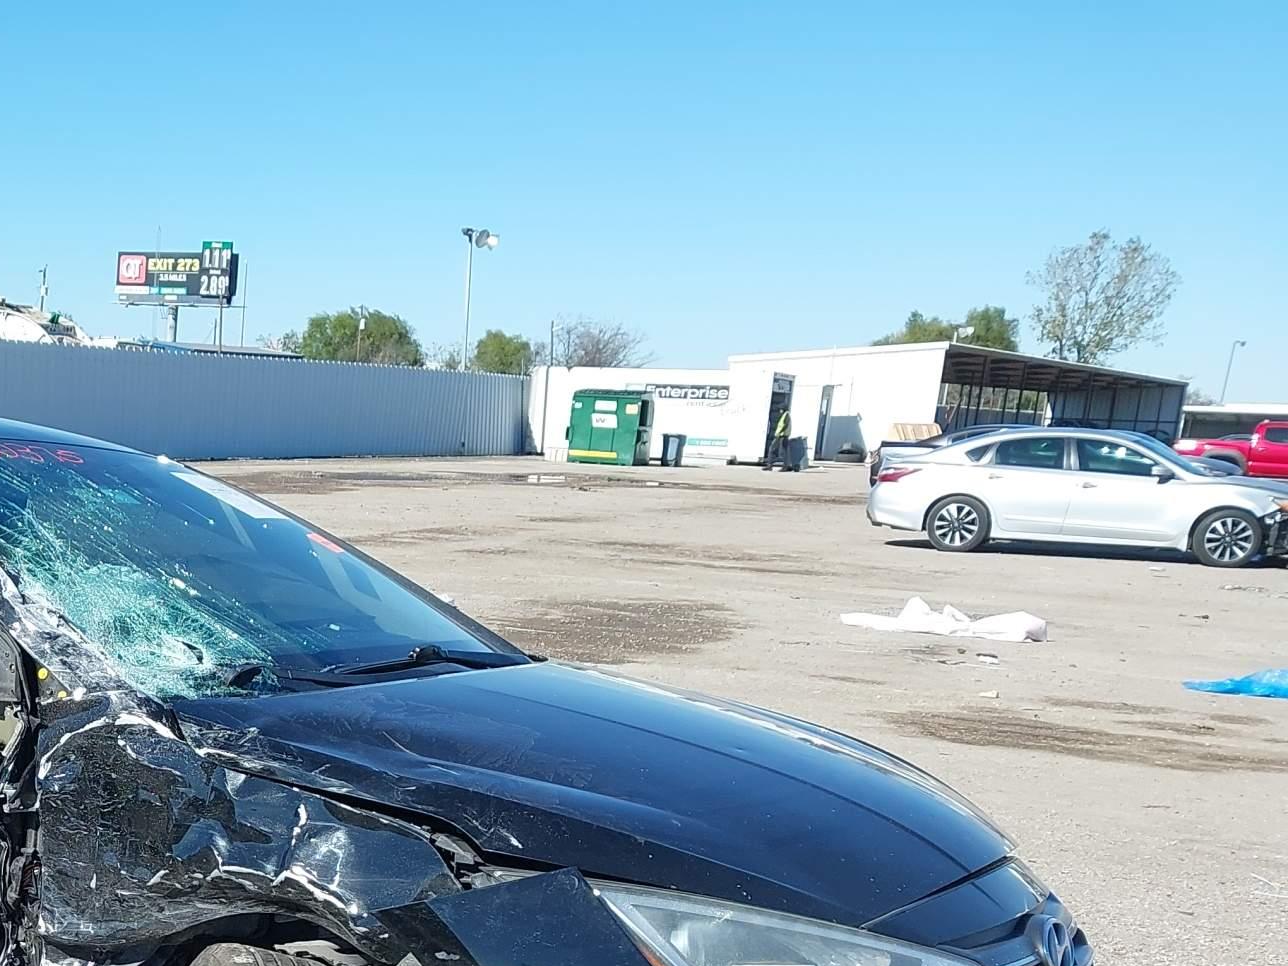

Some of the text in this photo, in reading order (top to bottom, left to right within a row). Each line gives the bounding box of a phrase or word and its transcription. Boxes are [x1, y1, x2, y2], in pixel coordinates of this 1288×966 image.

[121, 259, 143, 280] QT
[148, 258, 200, 271] EXIT 273
